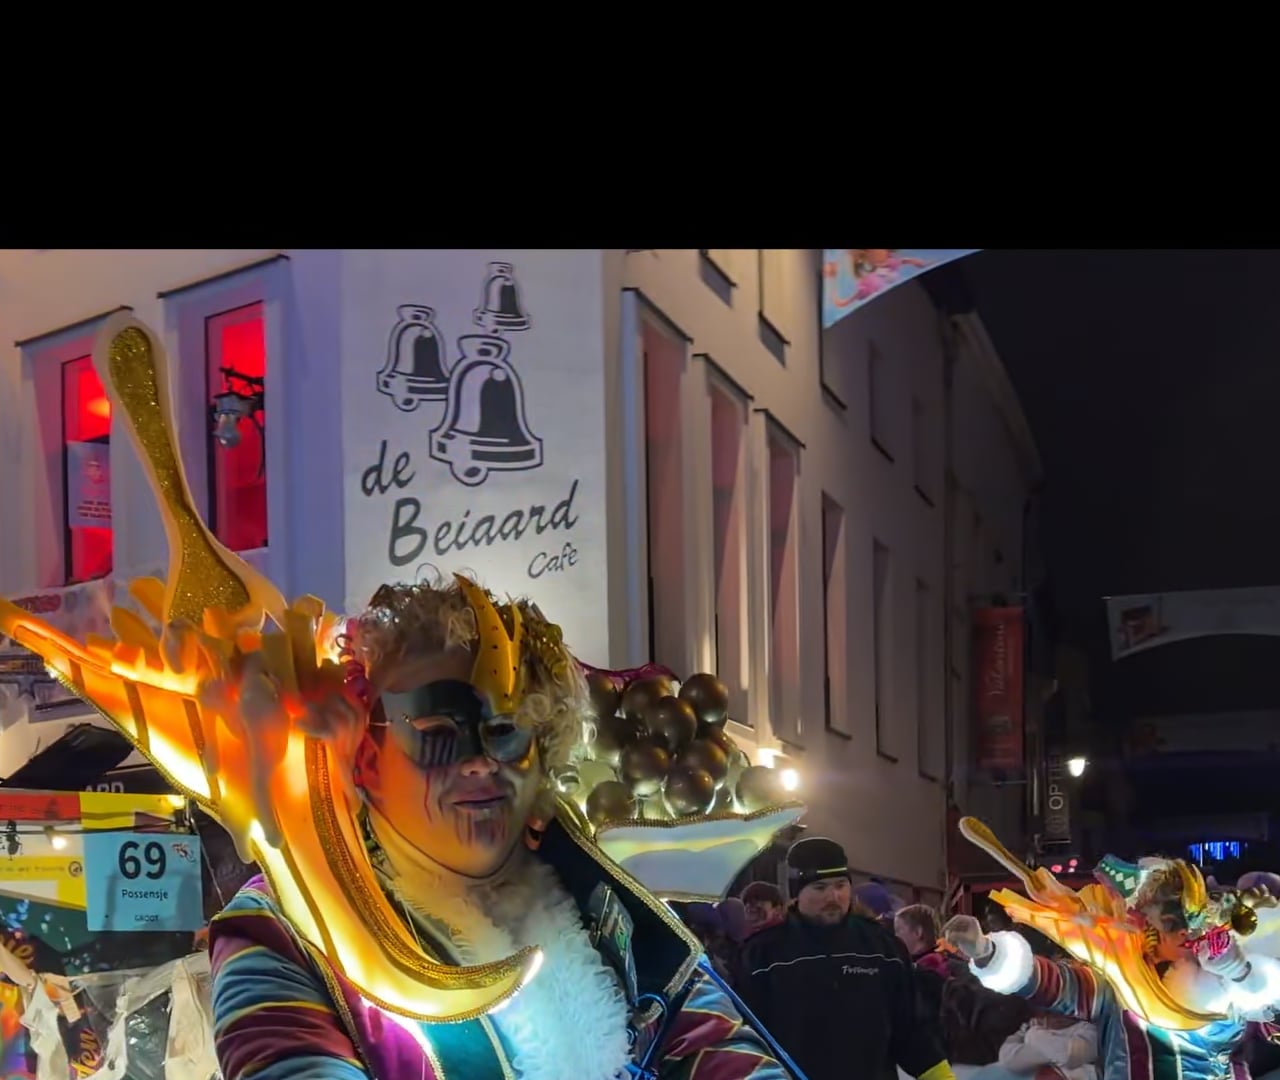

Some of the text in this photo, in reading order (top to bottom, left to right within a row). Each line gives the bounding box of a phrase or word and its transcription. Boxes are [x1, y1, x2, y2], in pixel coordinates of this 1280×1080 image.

[360, 440, 417, 497] de
[388, 479, 580, 567] Beiaard
[118, 840, 167, 880] 69
[121, 888, 169, 902] Possensje
